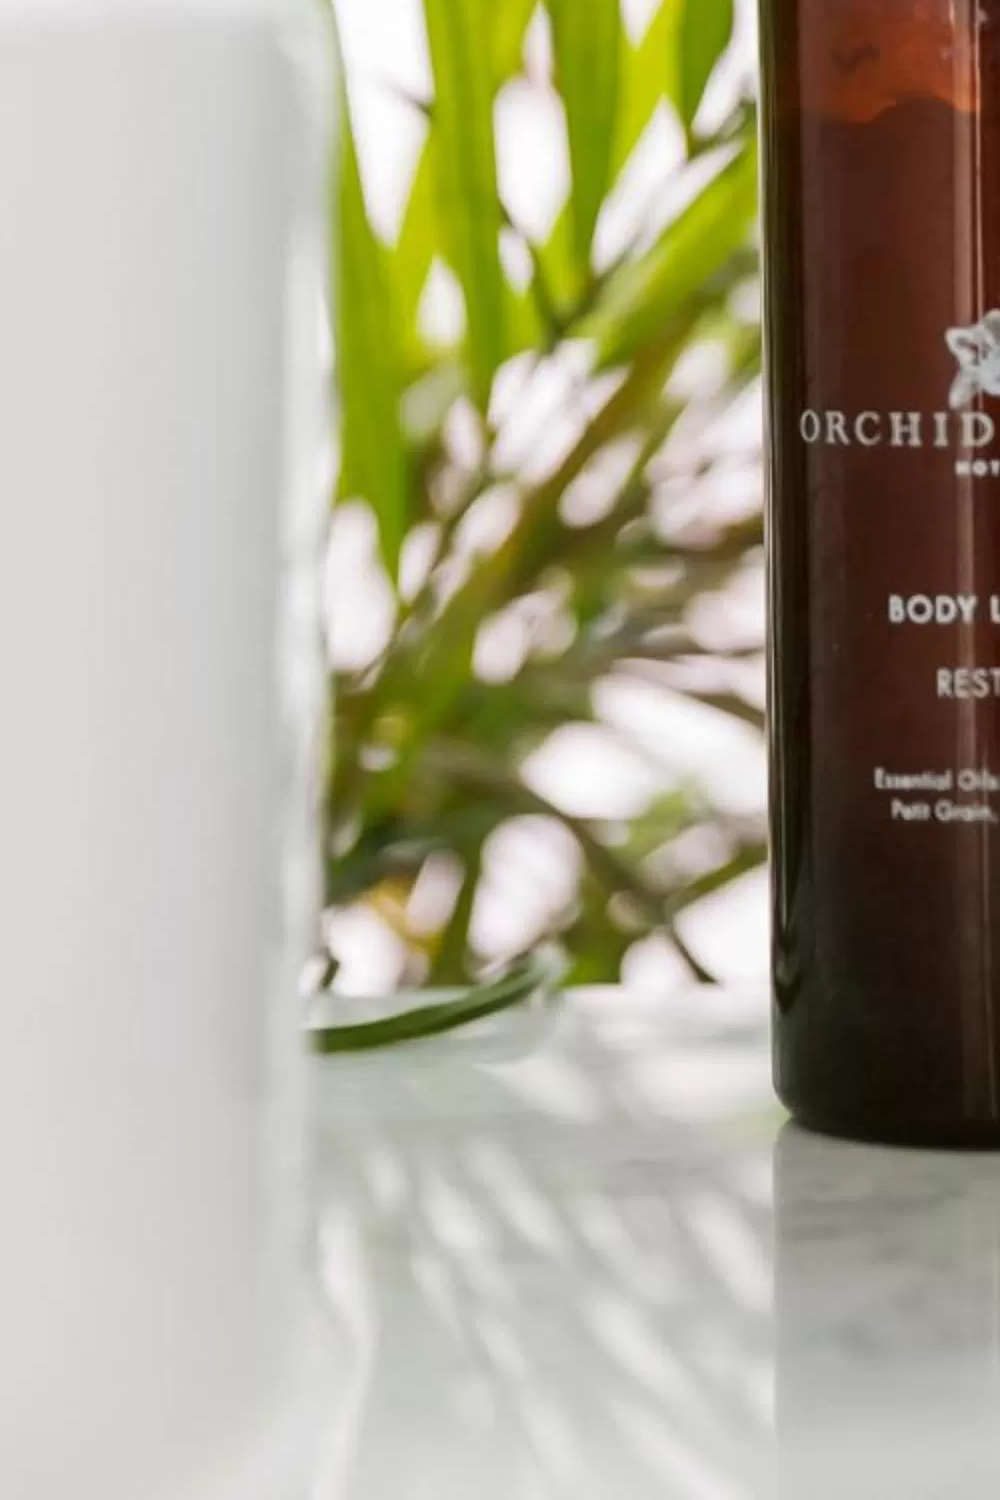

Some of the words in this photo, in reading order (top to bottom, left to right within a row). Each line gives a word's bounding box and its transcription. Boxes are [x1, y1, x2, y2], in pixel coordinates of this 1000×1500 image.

[800, 409, 995, 448] ORCHID
[889, 593, 977, 624] BODY
[873, 766, 952, 790] Essential
